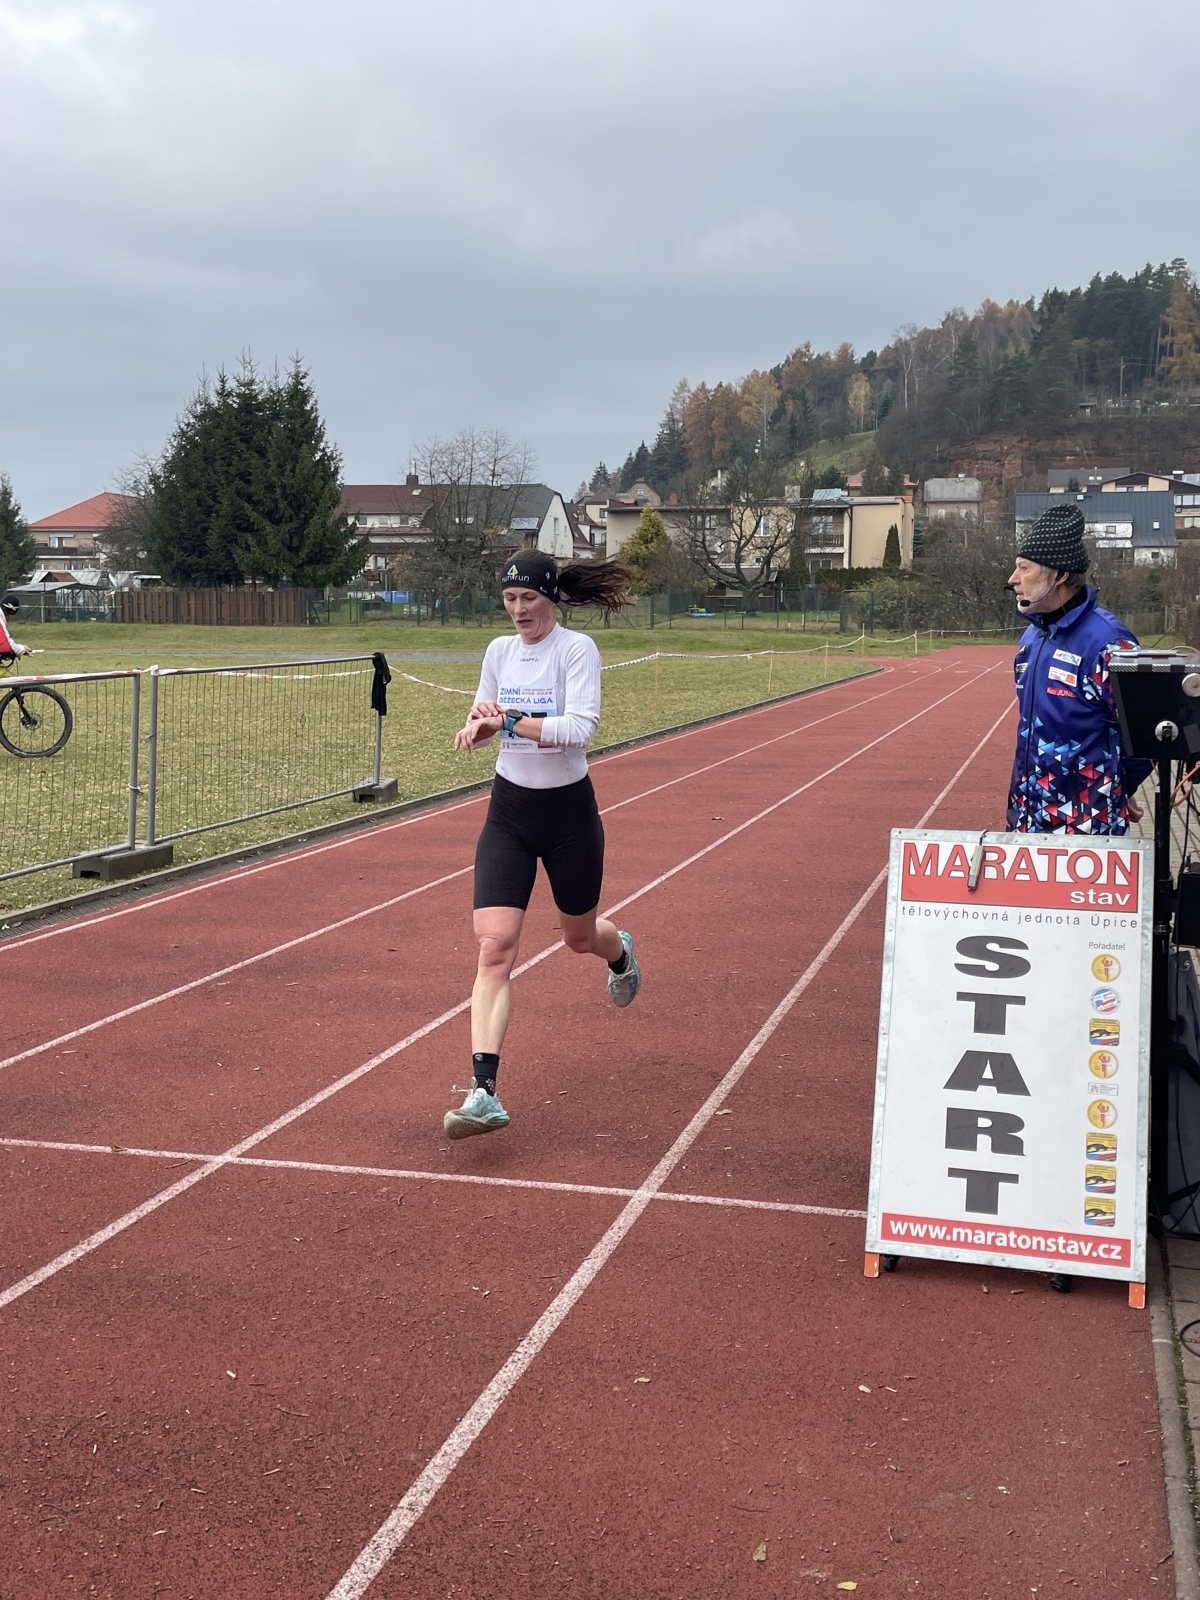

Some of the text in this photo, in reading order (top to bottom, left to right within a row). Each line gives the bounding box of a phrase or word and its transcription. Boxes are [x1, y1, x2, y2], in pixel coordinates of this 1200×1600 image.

[500, 687, 521, 695] ZIMNÍ
[903, 842, 1140, 886] MARATON
[1070, 889, 1131, 906] stav
[902, 906, 1138, 929] tělovýchovná jednota Úpice
[1088, 941, 1126, 950] Pořadatel
[943, 935, 1032, 1216] START
[889, 1220, 1123, 1261] www.maratonstav.cz
